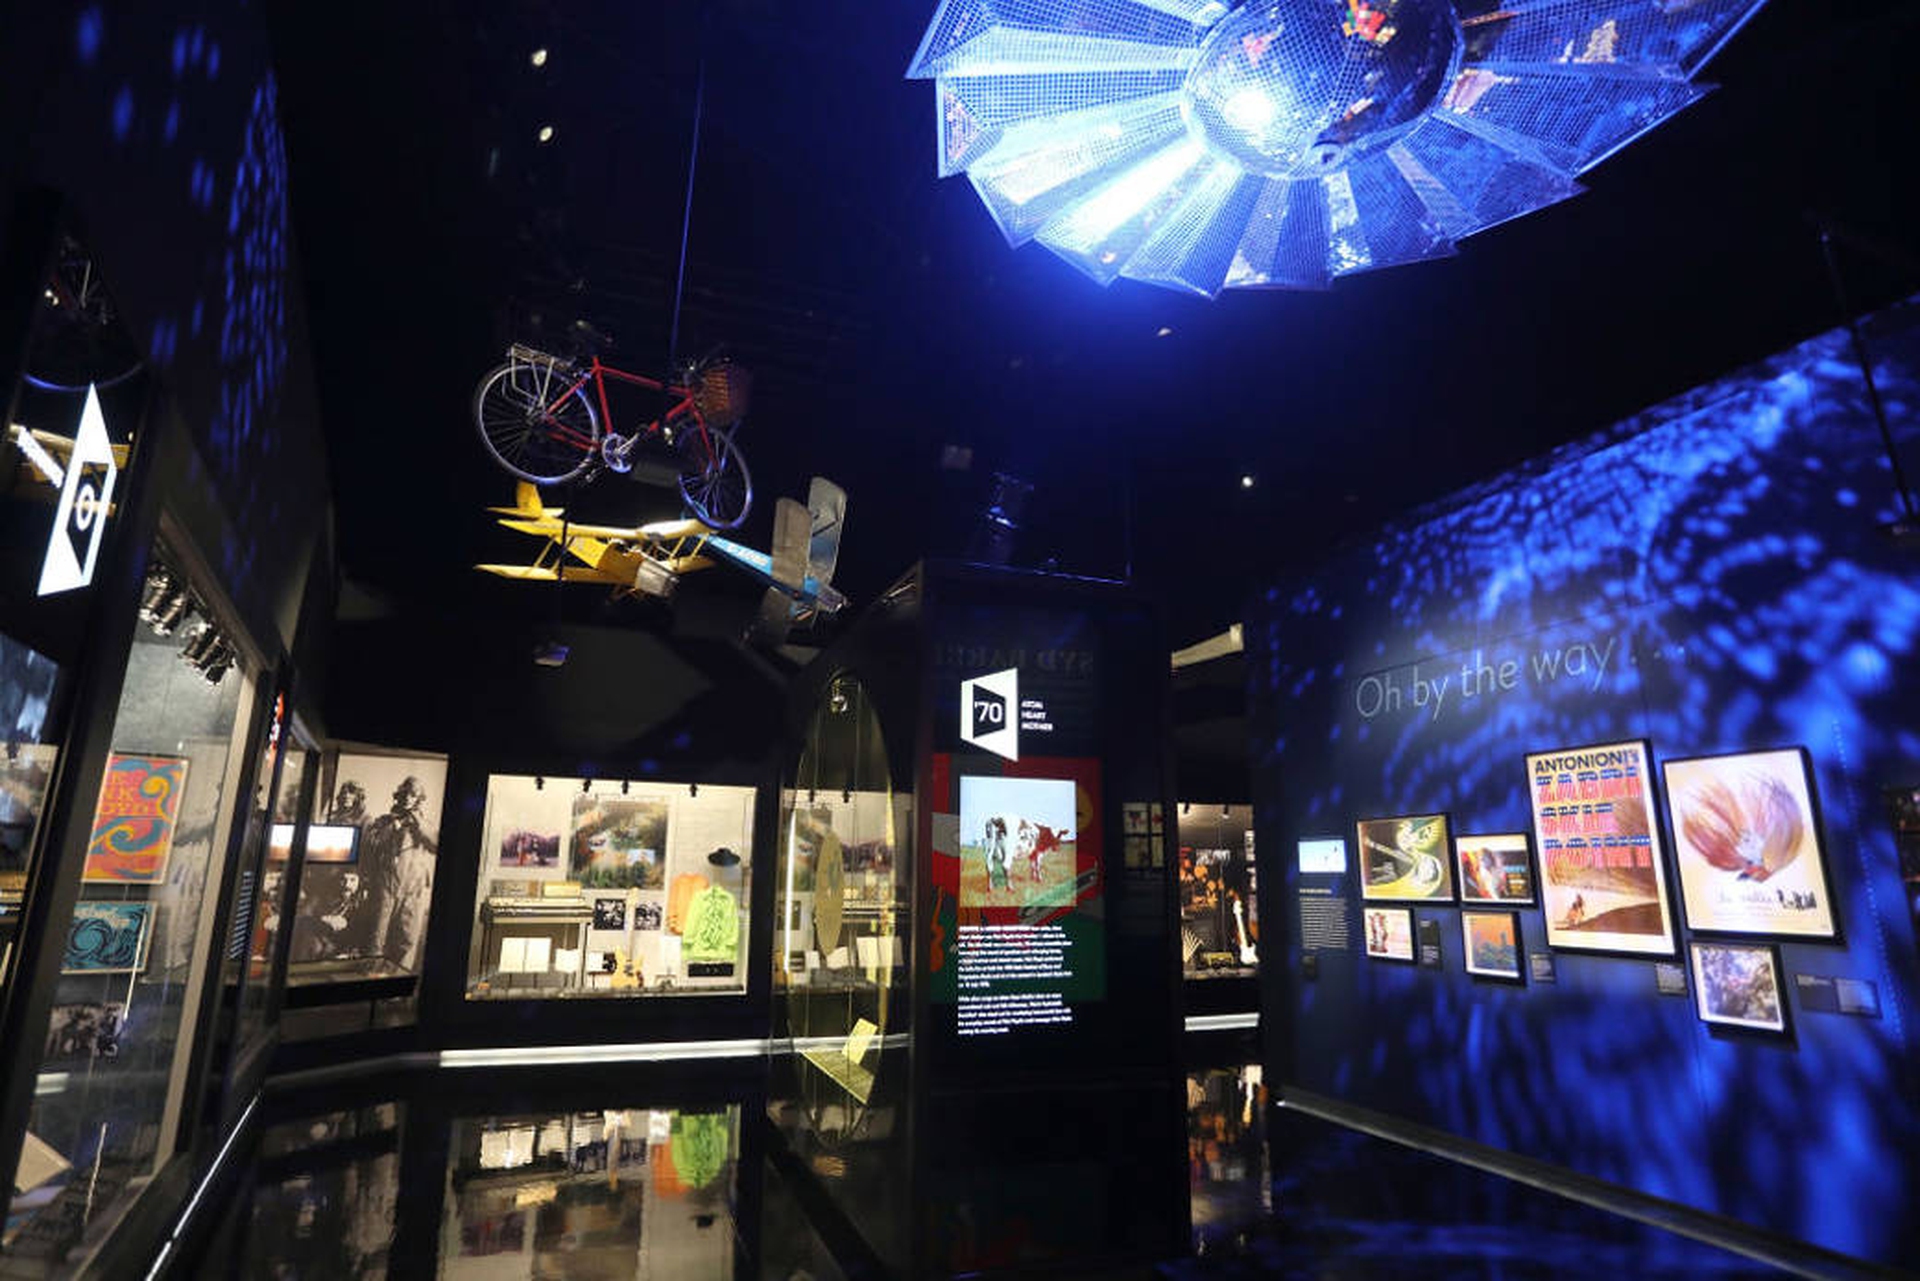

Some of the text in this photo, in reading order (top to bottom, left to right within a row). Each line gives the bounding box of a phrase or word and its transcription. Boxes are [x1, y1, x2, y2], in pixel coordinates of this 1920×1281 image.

[1357, 674, 1401, 717] Oh
[1413, 666, 1447, 721] by
[1461, 649, 1518, 696] the
[1532, 638, 1615, 692] way
